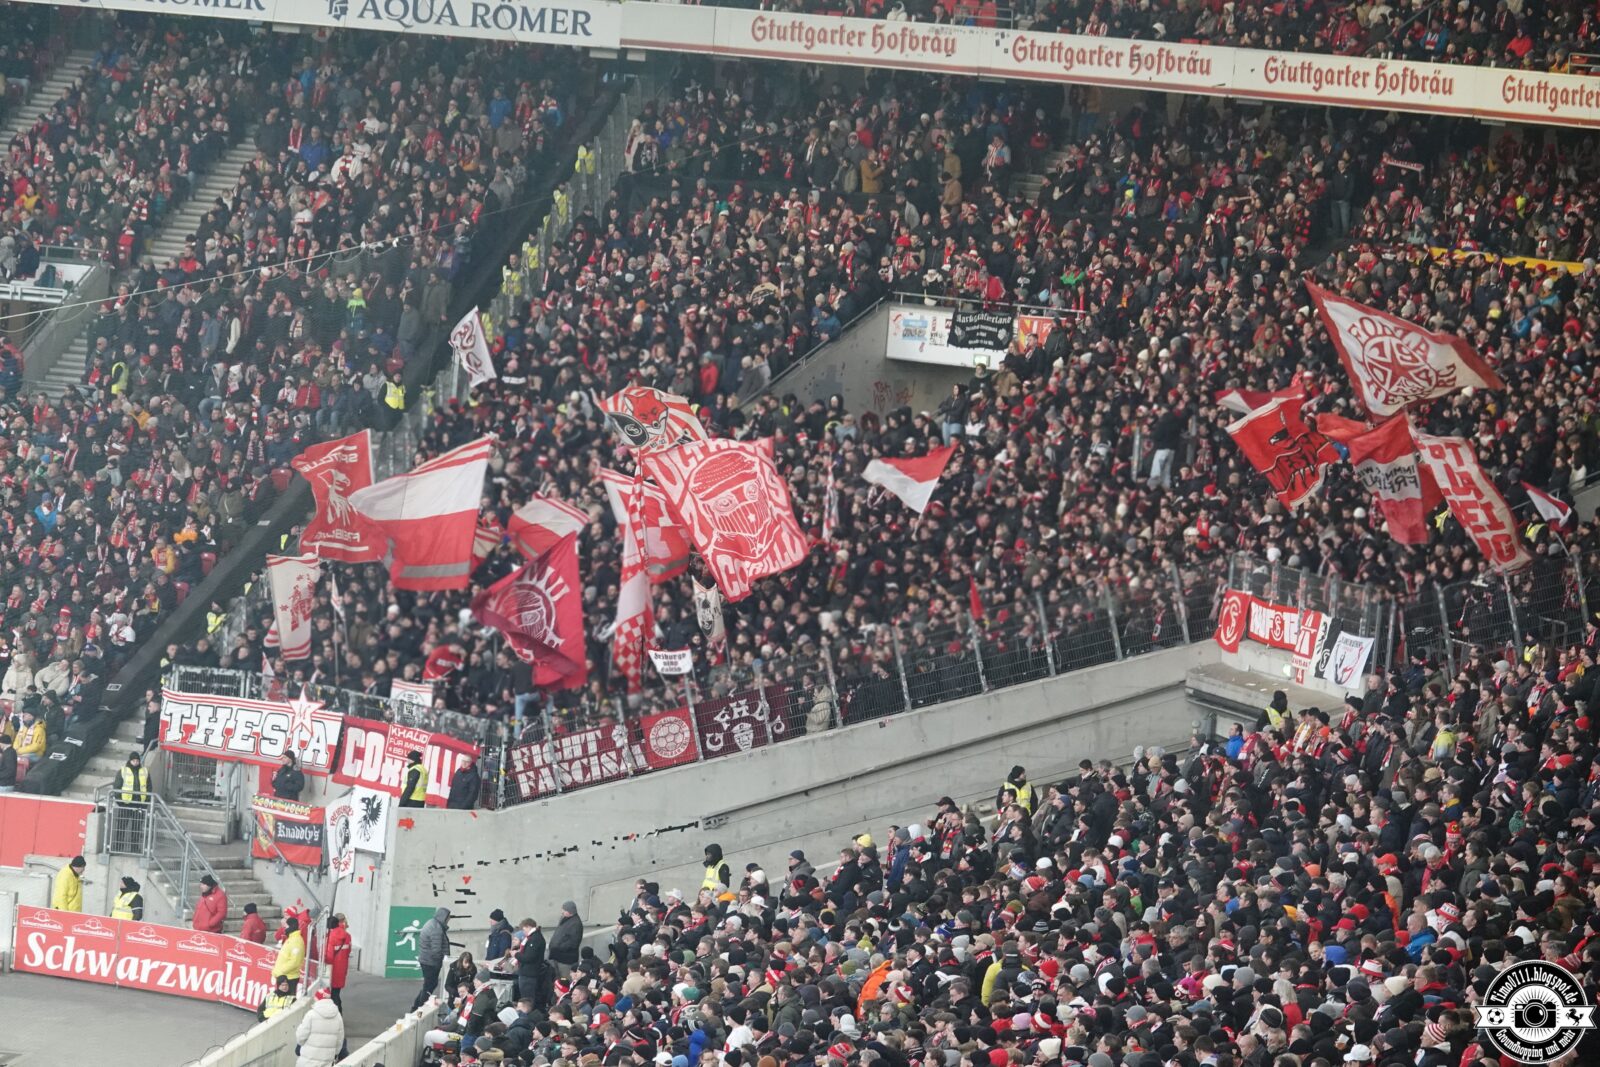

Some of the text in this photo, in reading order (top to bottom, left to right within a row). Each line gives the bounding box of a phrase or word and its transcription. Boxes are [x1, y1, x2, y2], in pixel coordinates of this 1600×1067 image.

[357, 0, 592, 36] AQUA RÖMER
[751, 15, 866, 50] Stuttgarter
[1012, 35, 1213, 75] Stuttgarter Hofbräu
[1264, 56, 1455, 96] Stuttgarter Hofbräu
[389, 738, 404, 747] FÜR
[391, 725, 429, 743] KHALID
[511, 730, 602, 772] FIGHT
